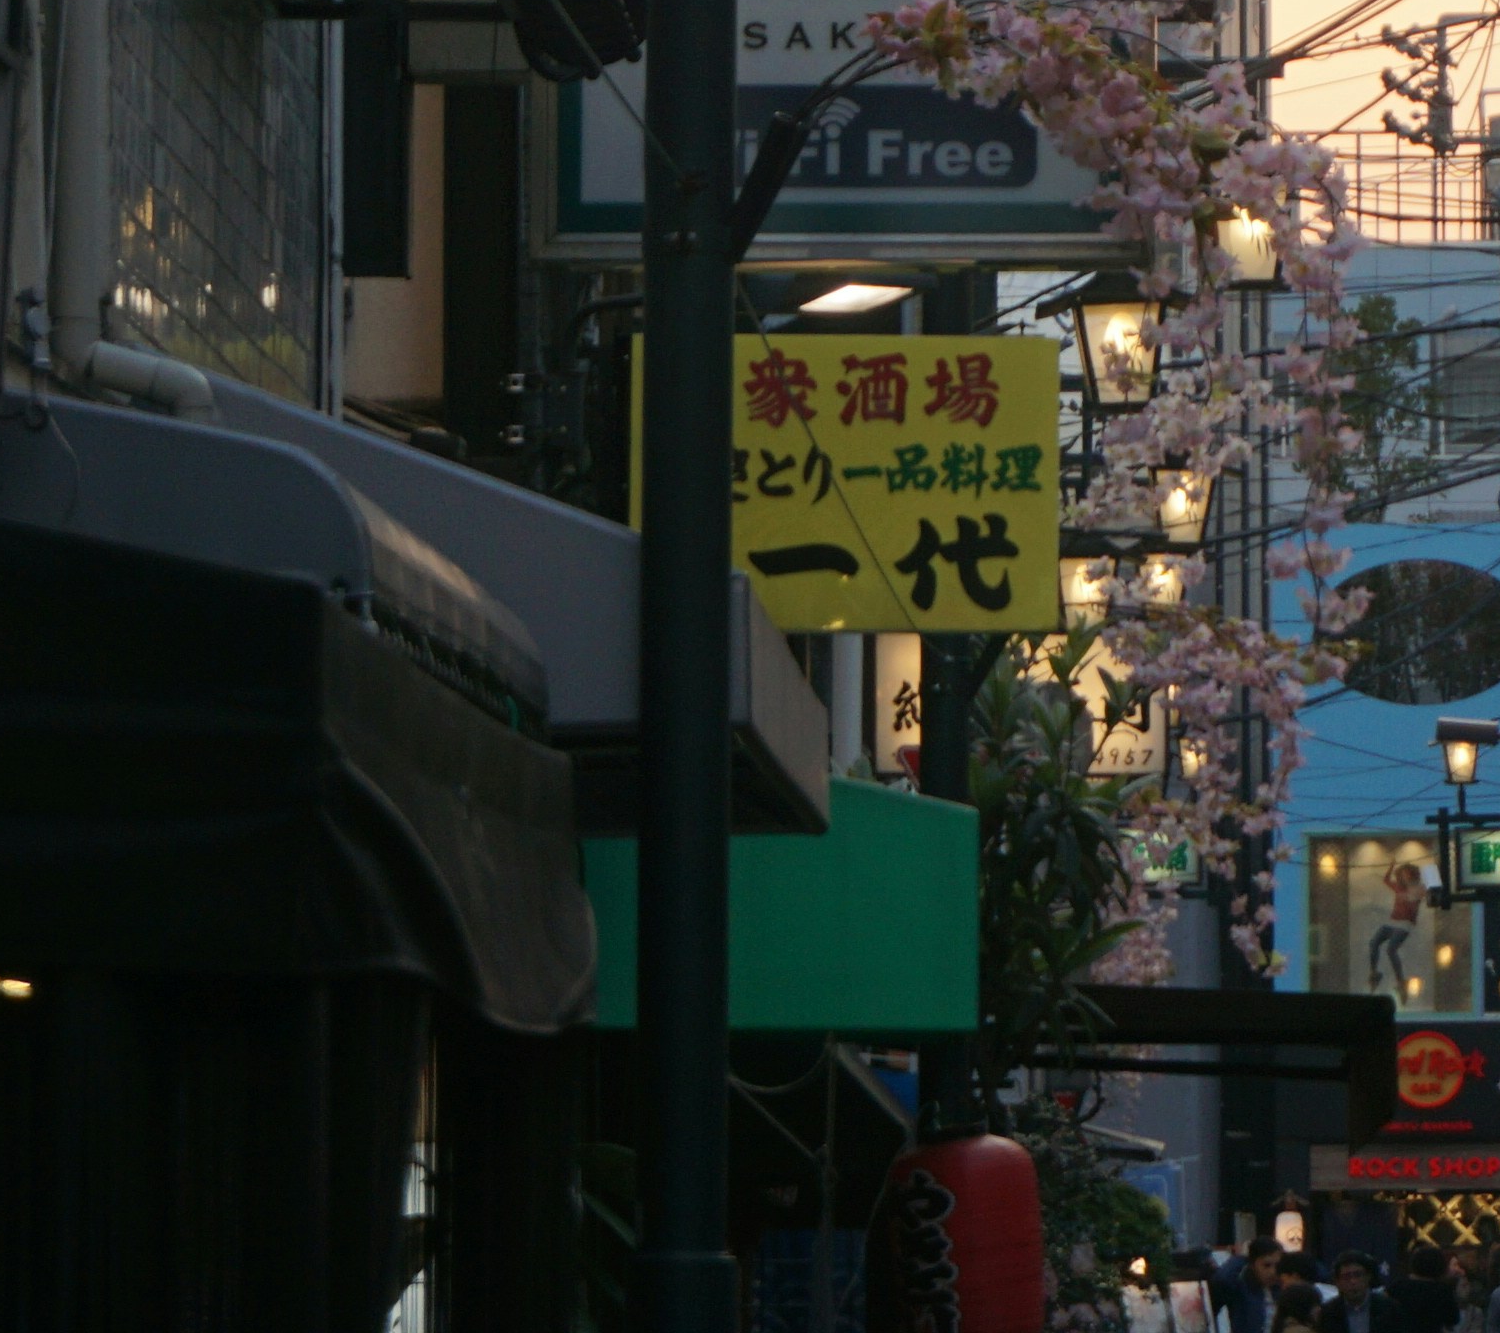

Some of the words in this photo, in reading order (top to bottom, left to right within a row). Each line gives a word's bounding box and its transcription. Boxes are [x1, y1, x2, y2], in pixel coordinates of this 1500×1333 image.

[866, 127, 1015, 177] Free
[743, 348, 1000, 428] 衆酒場
[747, 512, 1021, 612] 一代
[1348, 1156, 1420, 1178] ROCK
